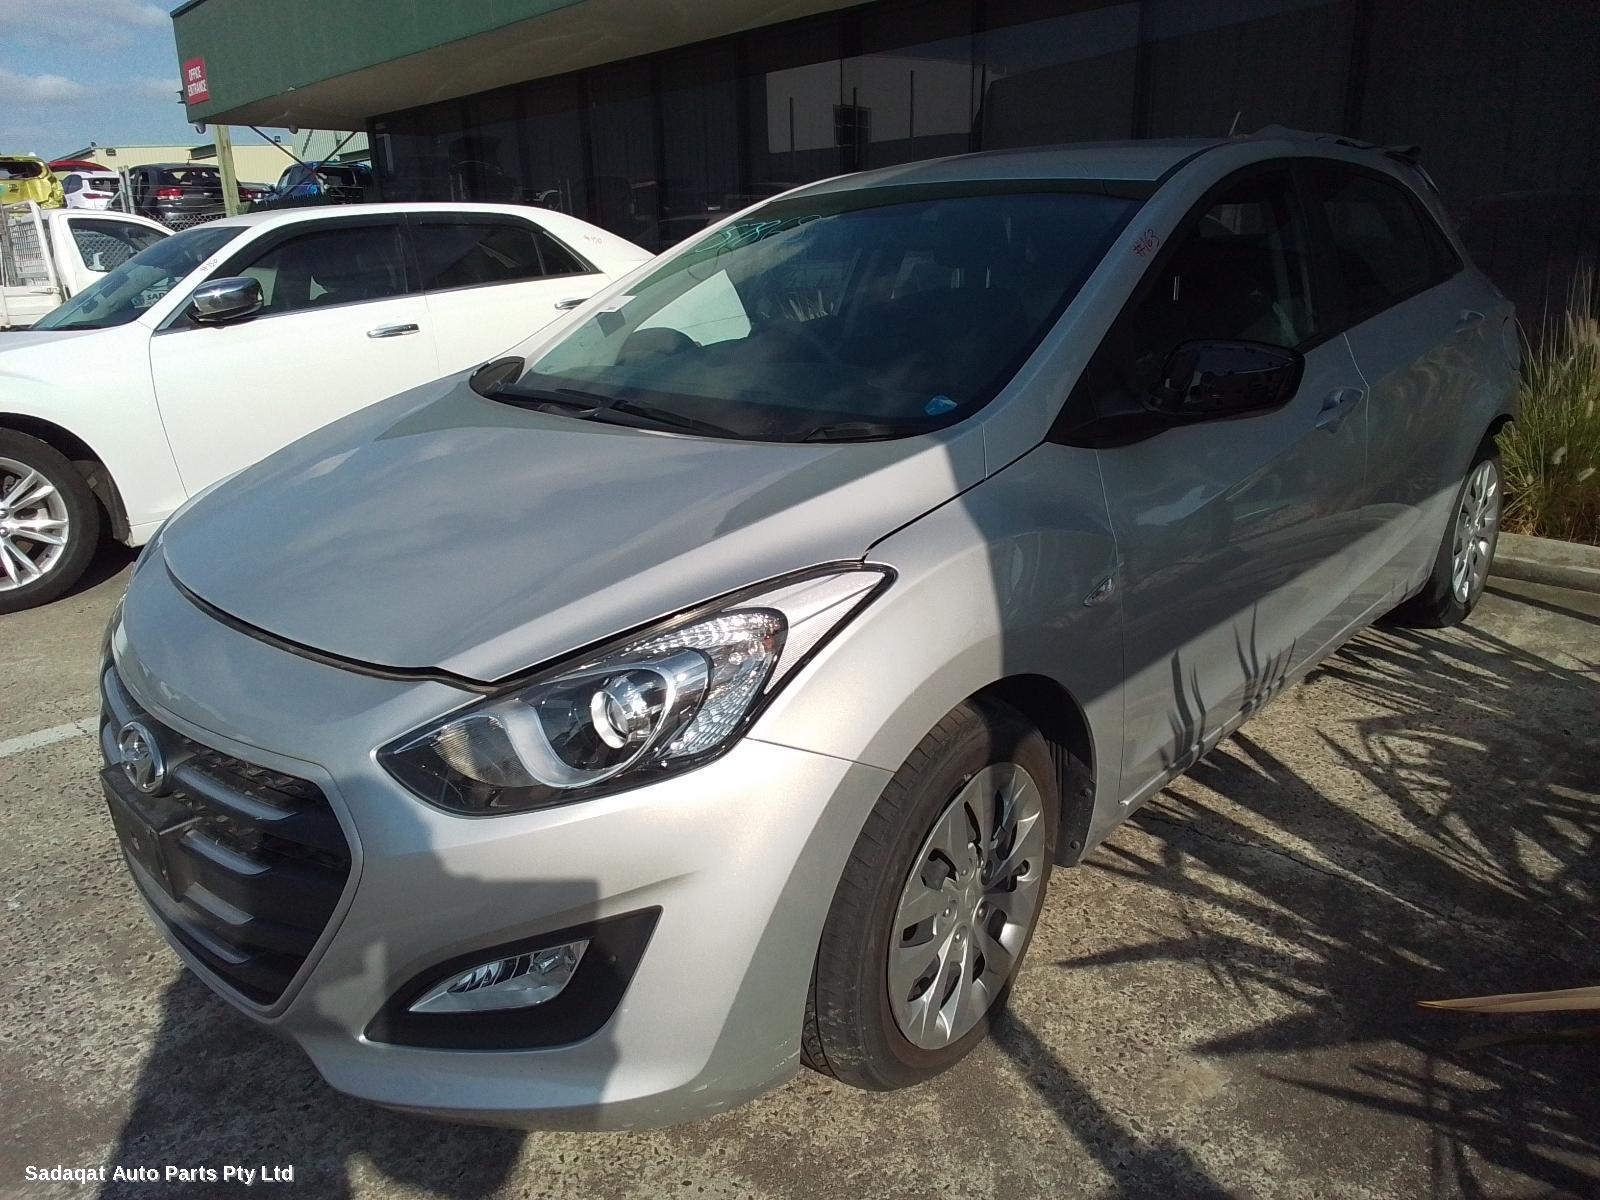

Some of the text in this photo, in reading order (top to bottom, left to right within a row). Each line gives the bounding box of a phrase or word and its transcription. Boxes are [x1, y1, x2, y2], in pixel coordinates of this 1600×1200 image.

[188, 65, 202, 81] OFFICE
[187, 79, 207, 96] ENTRANCE
[1133, 228, 1160, 256] #163
